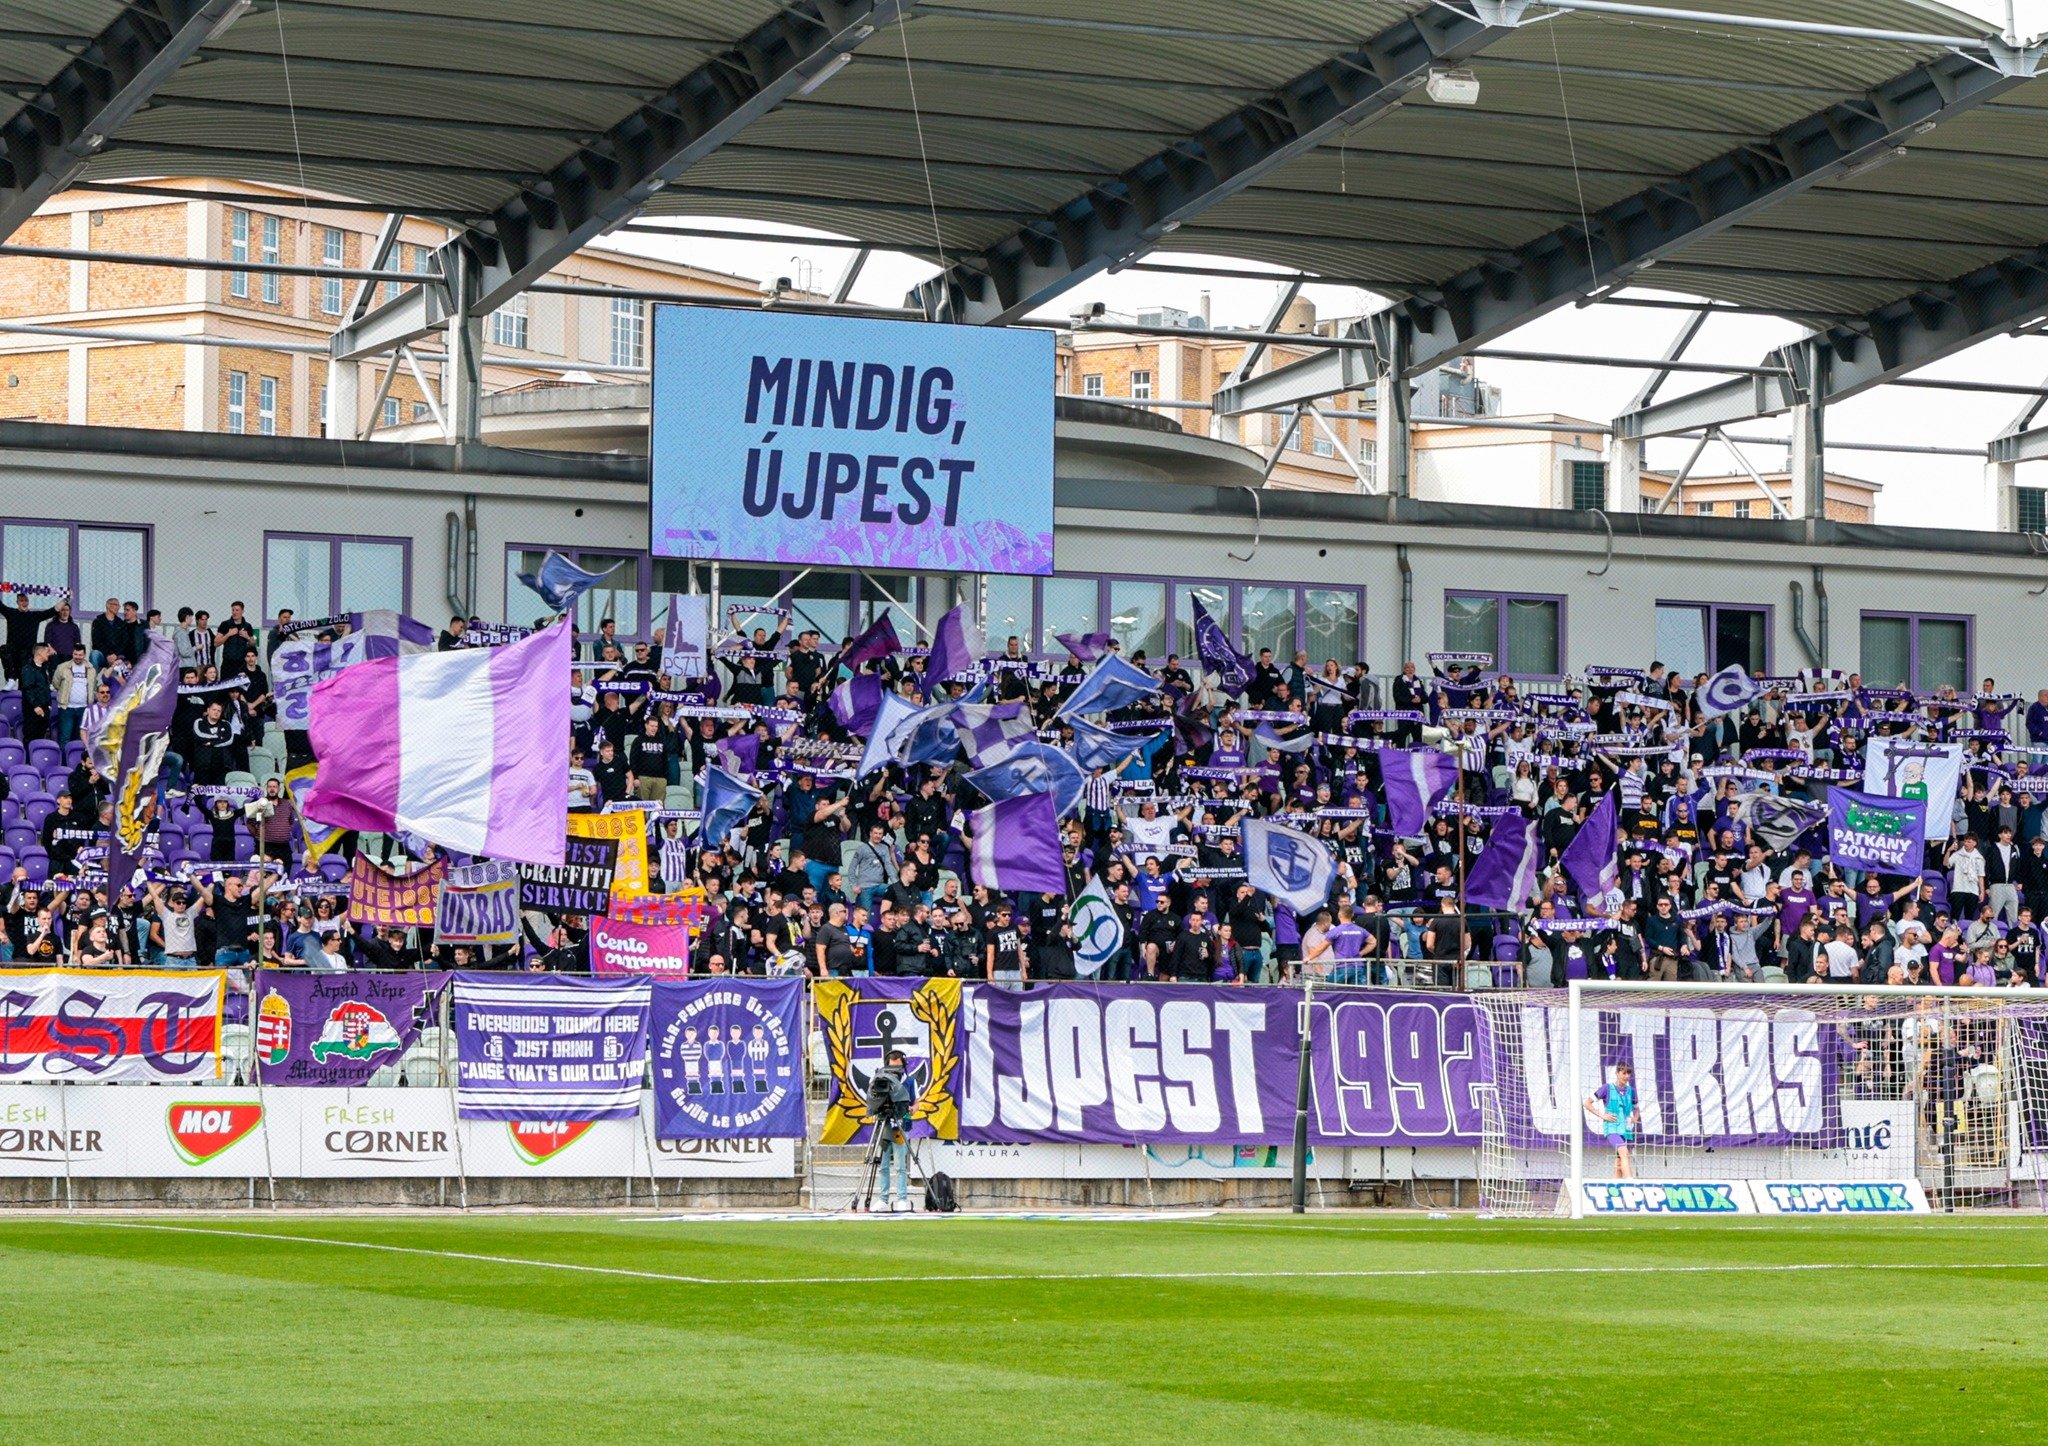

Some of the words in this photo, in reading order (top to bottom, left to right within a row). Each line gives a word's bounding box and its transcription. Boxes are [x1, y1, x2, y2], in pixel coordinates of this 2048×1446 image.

[744, 356, 966, 445] MINDIG,
[742, 431, 975, 526] ÚJPEST
[664, 656, 701, 677] PSZT
[599, 681, 642, 691] 1885
[1833, 828, 1912, 852] PATKÁNY
[521, 862, 613, 890] GRAFFITI
[353, 879, 391, 908] UTE
[522, 883, 607, 912] SERVICE
[351, 900, 393, 923] UTE
[395, 907, 437, 924] 188
[440, 888, 516, 935] ULTRAS
[596, 932, 648, 954] Cento
[365, 979, 406, 1001] Népe
[468, 1013, 549, 1033] EVERYBODY
[605, 1015, 640, 1033] HERE
[513, 1040, 549, 1058] JUST
[552, 1040, 594, 1058] DRINK
[459, 1061, 505, 1081] 'CAUSE
[506, 1063, 558, 1082] THAT'S
[561, 1065, 590, 1082] OUR
[1298, 1002, 1505, 1137] 1992
[0, 1103, 47, 1122] ESH
[178, 1110, 233, 1134] MOL
[324, 1106, 396, 1125] FRESH
[712, 1114, 730, 1128] LE
[324, 1130, 449, 1153] CORNER
[955, 1149, 1020, 1157] NATURA
